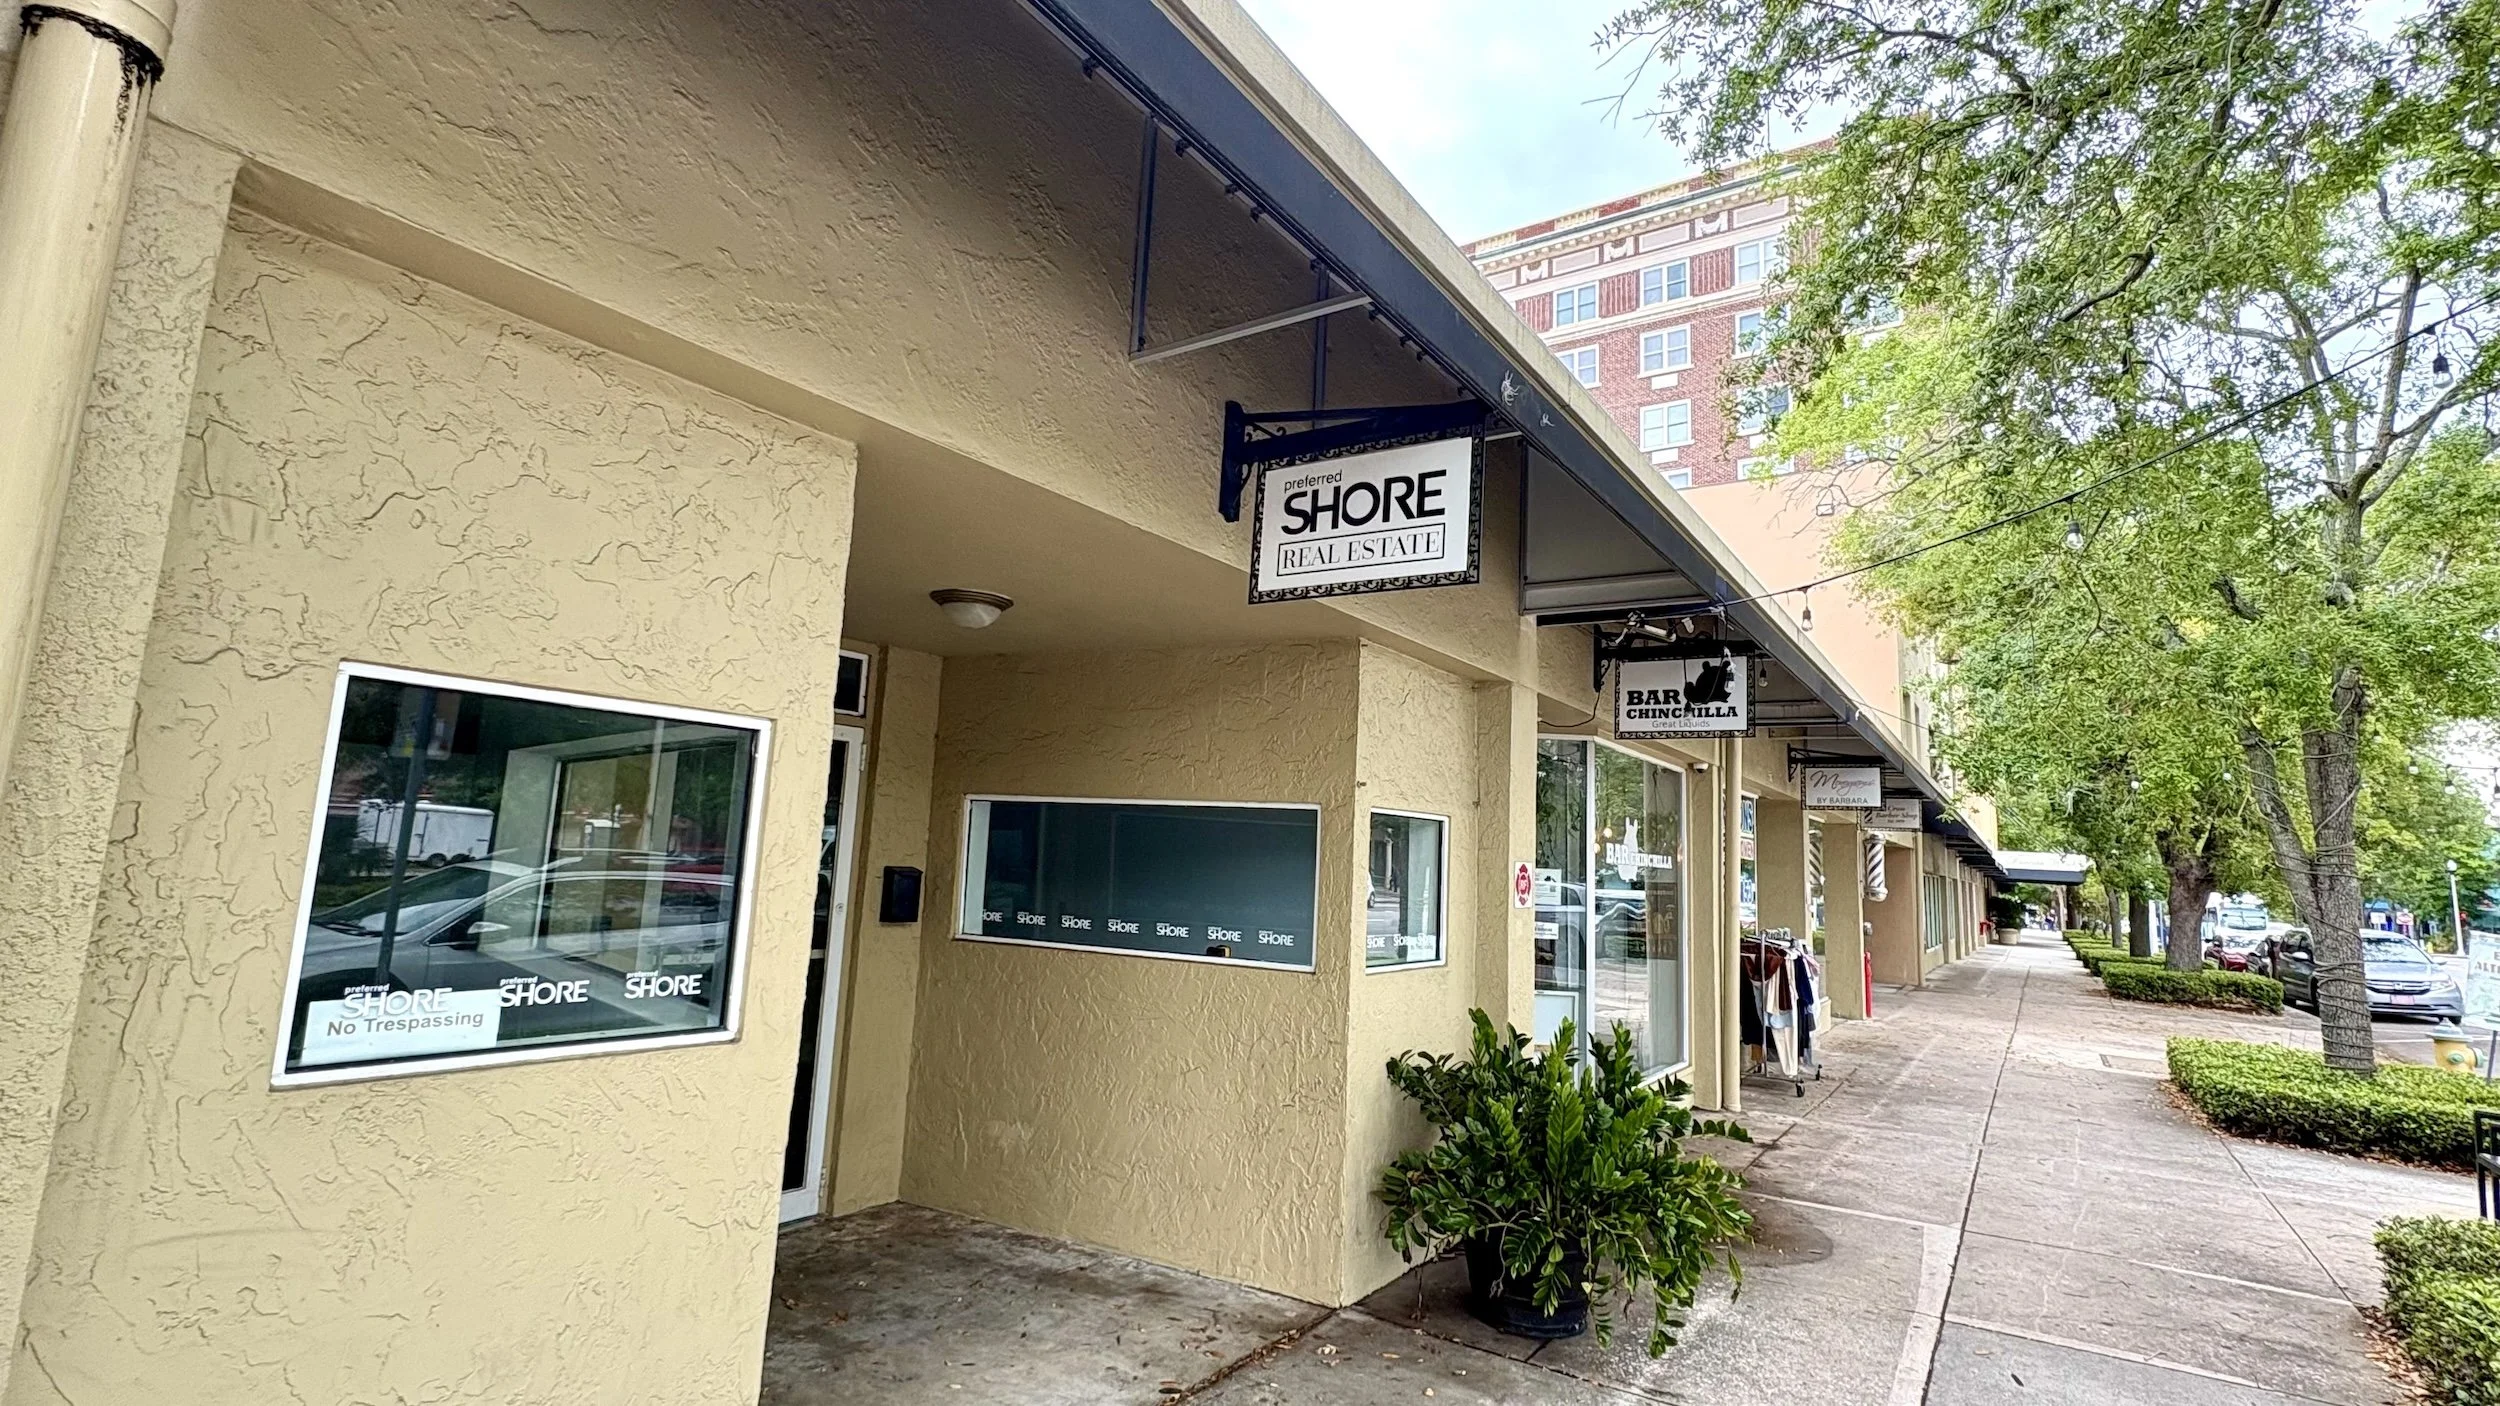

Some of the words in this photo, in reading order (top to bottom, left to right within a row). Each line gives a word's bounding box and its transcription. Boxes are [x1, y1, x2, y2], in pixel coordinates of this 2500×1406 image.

[1284, 469, 1342, 494] preferred
[1281, 469, 1447, 535] SHORE
[1282, 547, 1340, 569] REAL
[1348, 531, 1440, 562] ESTATE
[1626, 689, 1681, 706] BAR
[1652, 719, 1676, 728] Great
[1605, 842, 1629, 866] BAR
[1017, 913, 1046, 926] SHORE
[1061, 917, 1092, 930] SHORE
[1107, 921, 1140, 934] SHORE
[1156, 925, 1190, 938] SHORE
[1207, 929, 1242, 942] SHORE
[1258, 933, 1294, 946] SHORE
[344, 984, 390, 995] preferred
[499, 980, 590, 1007] SHORE
[623, 974, 703, 999] SHORE
[341, 988, 453, 1019] SHORE
[327, 1020, 357, 1036] No
[364, 1011, 484, 1034] Trespassing
